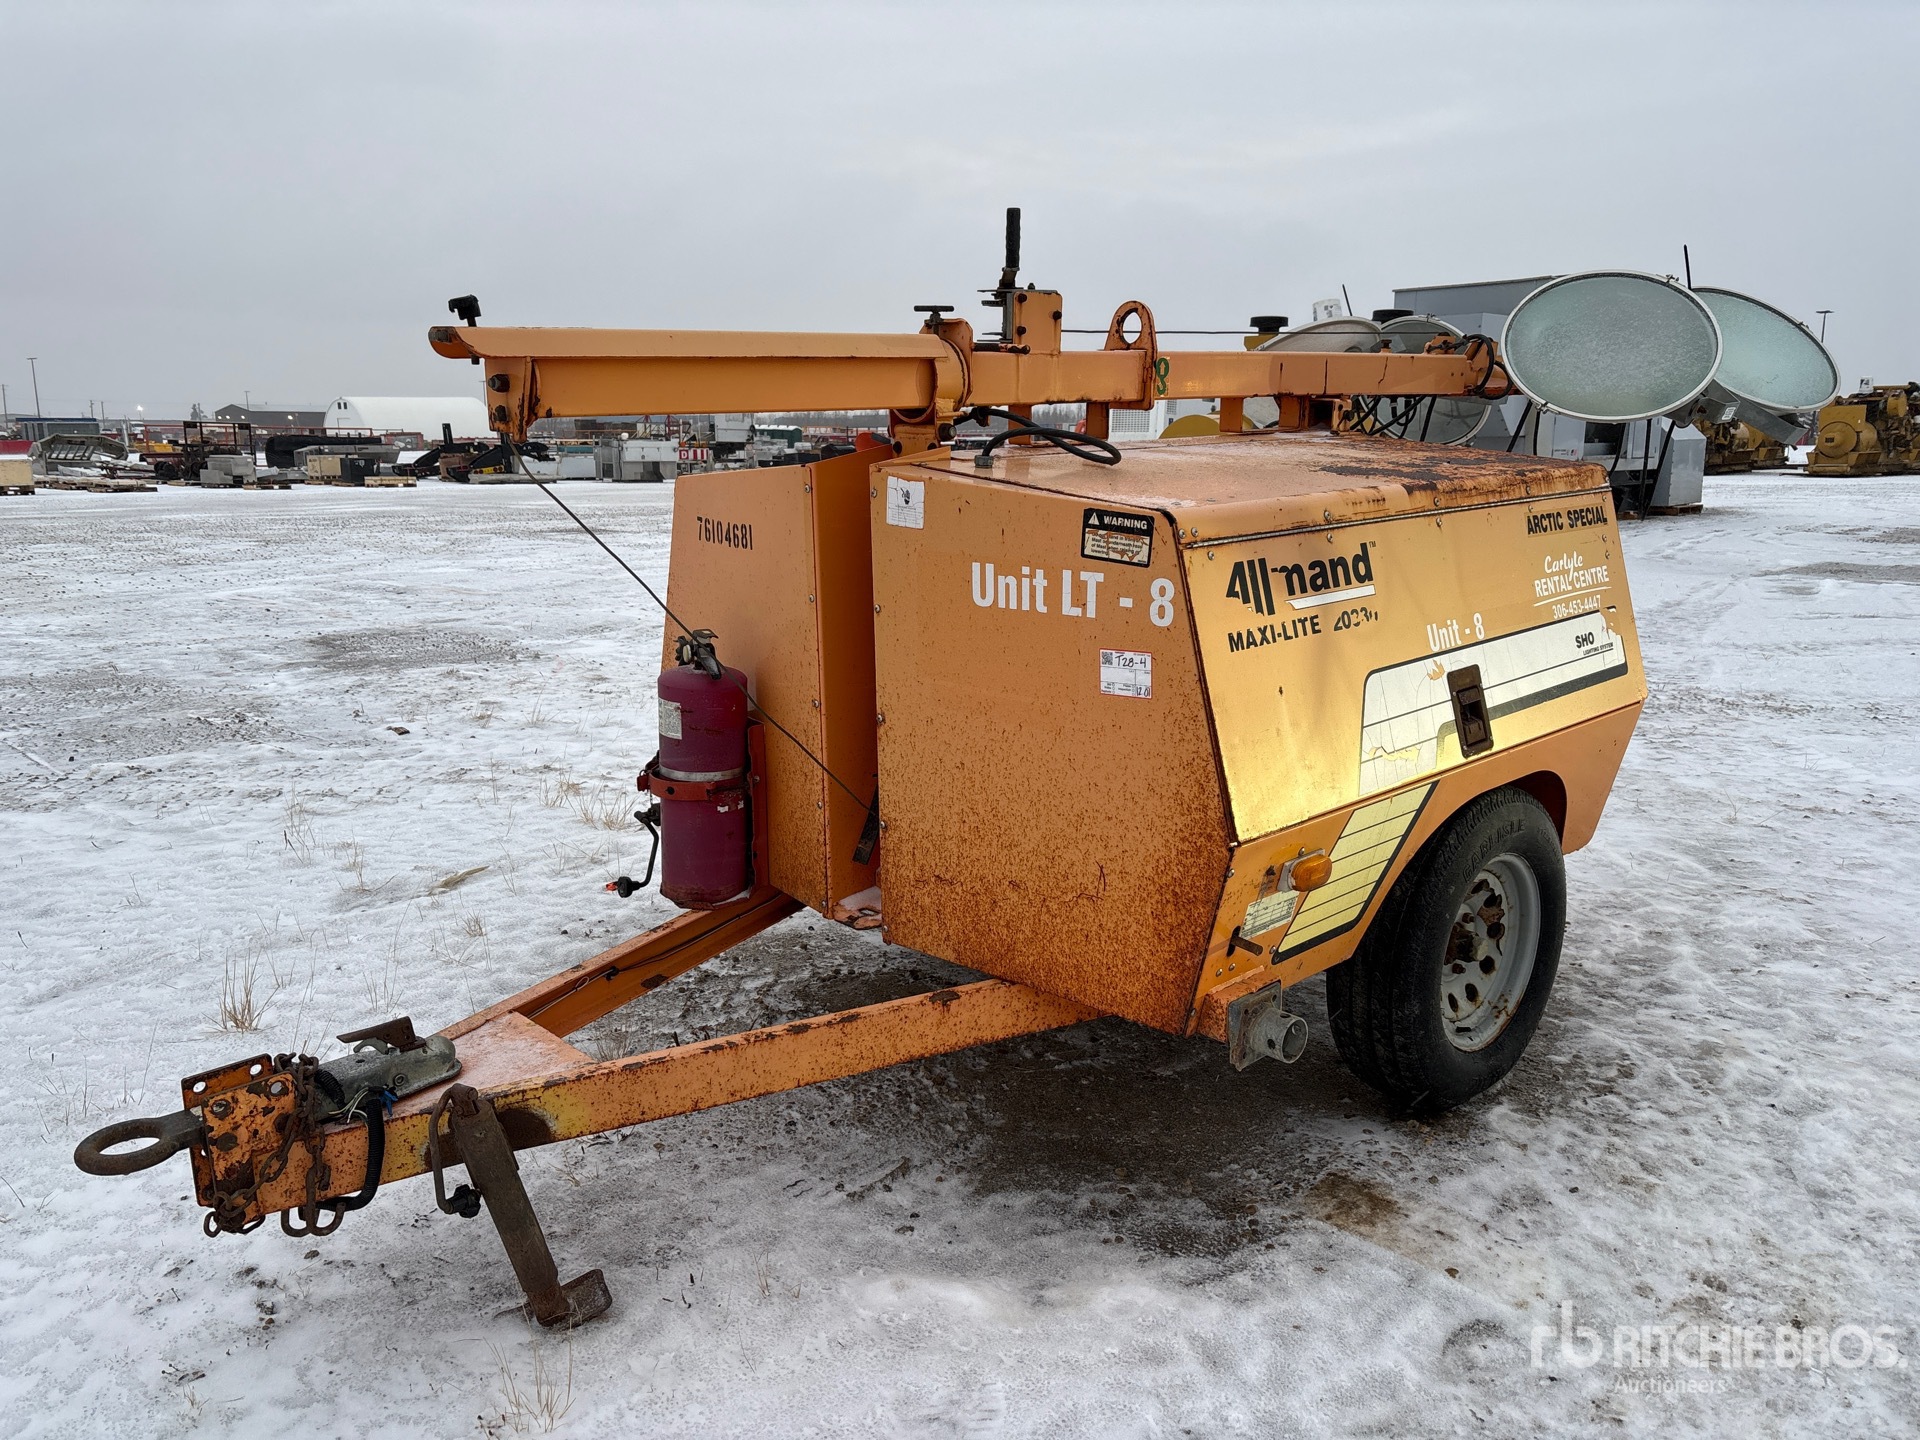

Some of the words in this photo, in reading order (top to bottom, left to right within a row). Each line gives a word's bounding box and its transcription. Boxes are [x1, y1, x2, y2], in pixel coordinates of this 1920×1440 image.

[696, 516, 753, 550] 76104681
[1103, 515, 1148, 530] WARNING
[1527, 512, 1564, 535] ARCTIC
[1566, 505, 1608, 529] SPECIAL
[1534, 574, 1573, 598] RENTAL
[1573, 565, 1609, 589] CENTRE
[1544, 550, 1583, 582] Carlyle
[972, 562, 1047, 613] Unit
[1062, 569, 1104, 618] LT
[1119, 597, 1133, 608] -
[1150, 577, 1175, 627] 8
[1552, 595, 1601, 619] 306-453-4447
[1228, 614, 1321, 653] MAXI-LITE
[1426, 619, 1462, 652] Unit
[1473, 612, 1485, 640] 8
[1575, 631, 1595, 649] SHO
